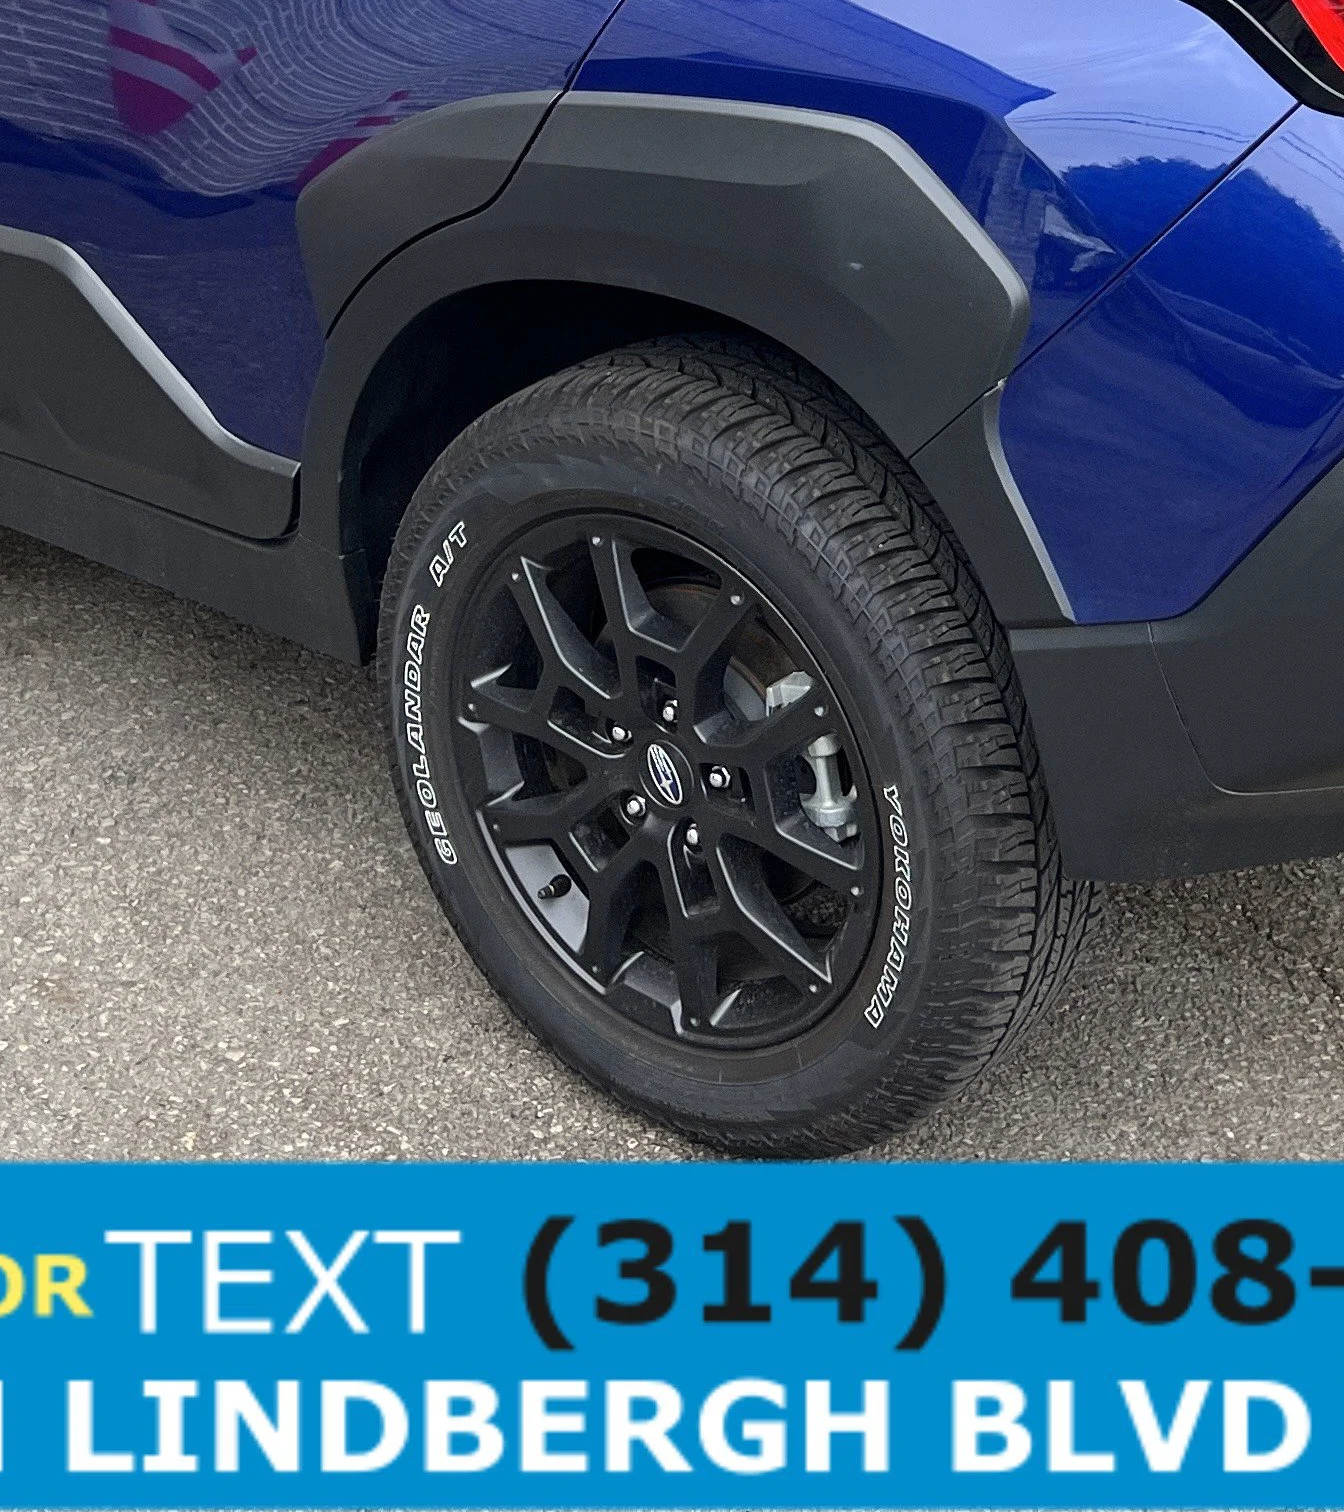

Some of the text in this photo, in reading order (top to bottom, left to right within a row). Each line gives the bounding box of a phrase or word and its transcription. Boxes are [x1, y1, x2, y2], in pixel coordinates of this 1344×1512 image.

[399, 521, 468, 865] GEOLANDAR A/T
[863, 784, 914, 1029] YOKOHAMA
